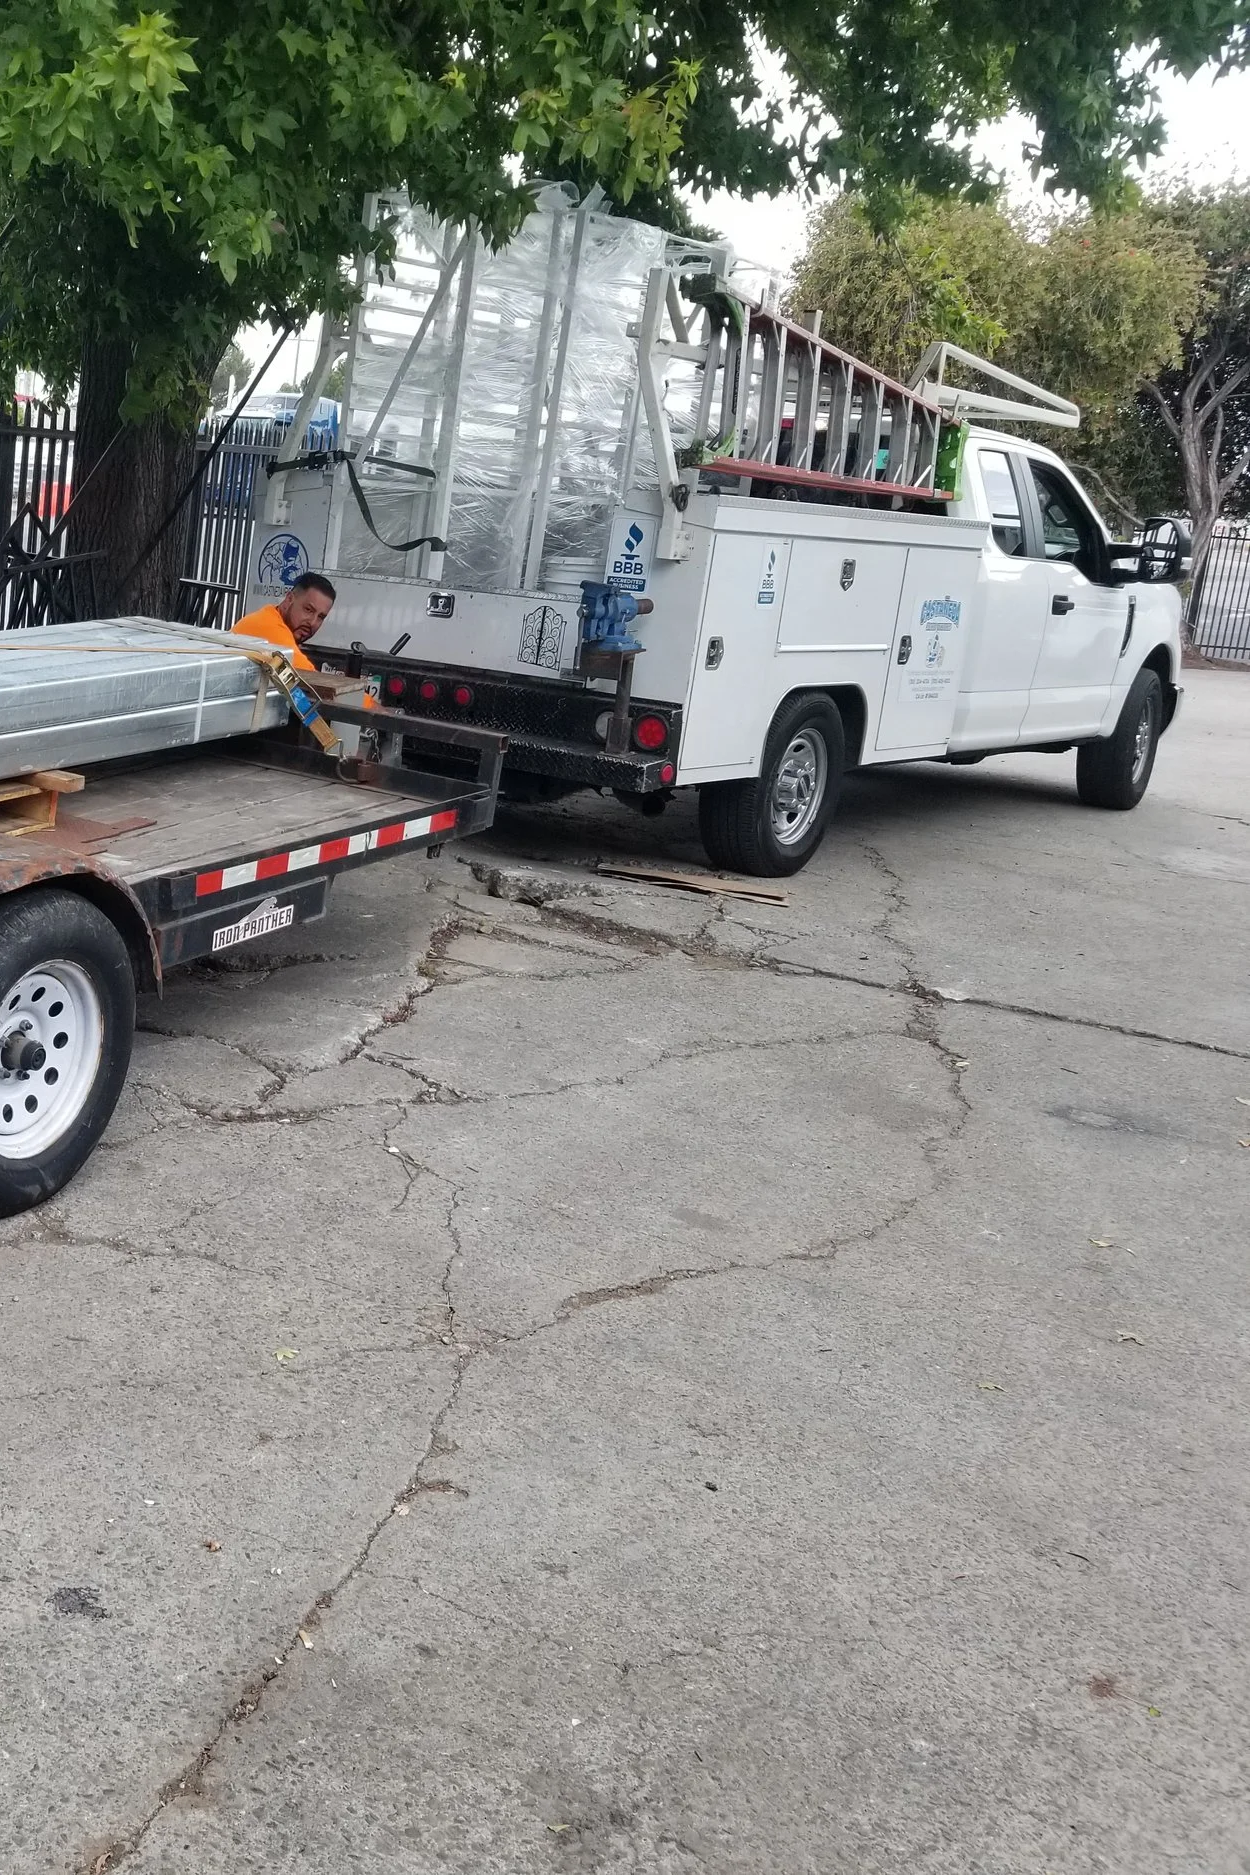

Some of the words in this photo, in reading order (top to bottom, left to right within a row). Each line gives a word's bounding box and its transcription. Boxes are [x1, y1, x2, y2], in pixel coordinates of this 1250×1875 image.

[613, 561, 644, 575] BBB
[609, 577, 644, 585] ACCREDITED
[213, 924, 241, 950] IRON
[242, 907, 293, 939] PANTHER
